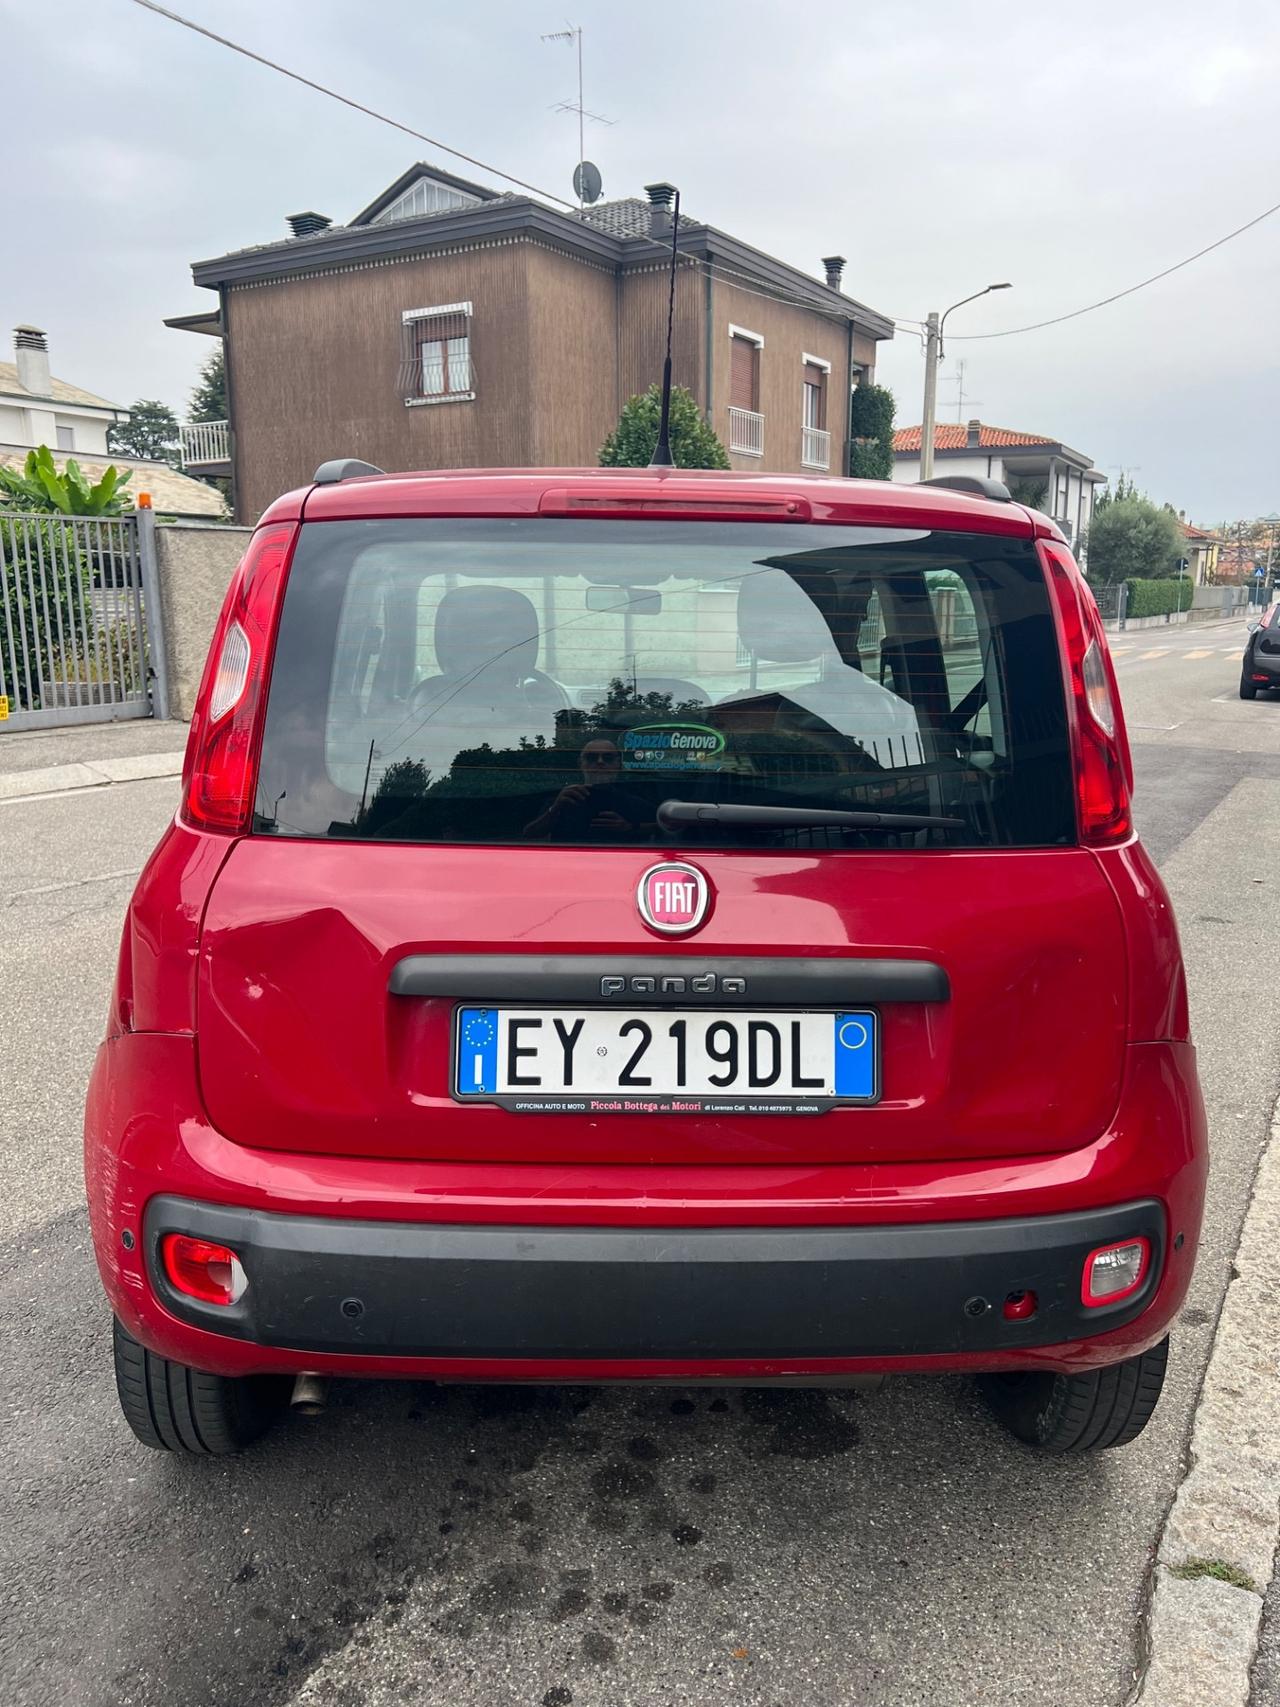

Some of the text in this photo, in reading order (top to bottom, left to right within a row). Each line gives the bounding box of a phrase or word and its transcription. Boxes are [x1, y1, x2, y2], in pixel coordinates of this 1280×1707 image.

[624, 732, 717, 751] SpazioGenova
[655, 882, 696, 913] FIAT
[601, 971, 746, 997] panda
[507, 1018, 825, 1089] EY 219DL
[590, 1101, 622, 1110] Piccola
[624, 1101, 658, 1112] Bottega
[672, 1101, 701, 1110] Motori
